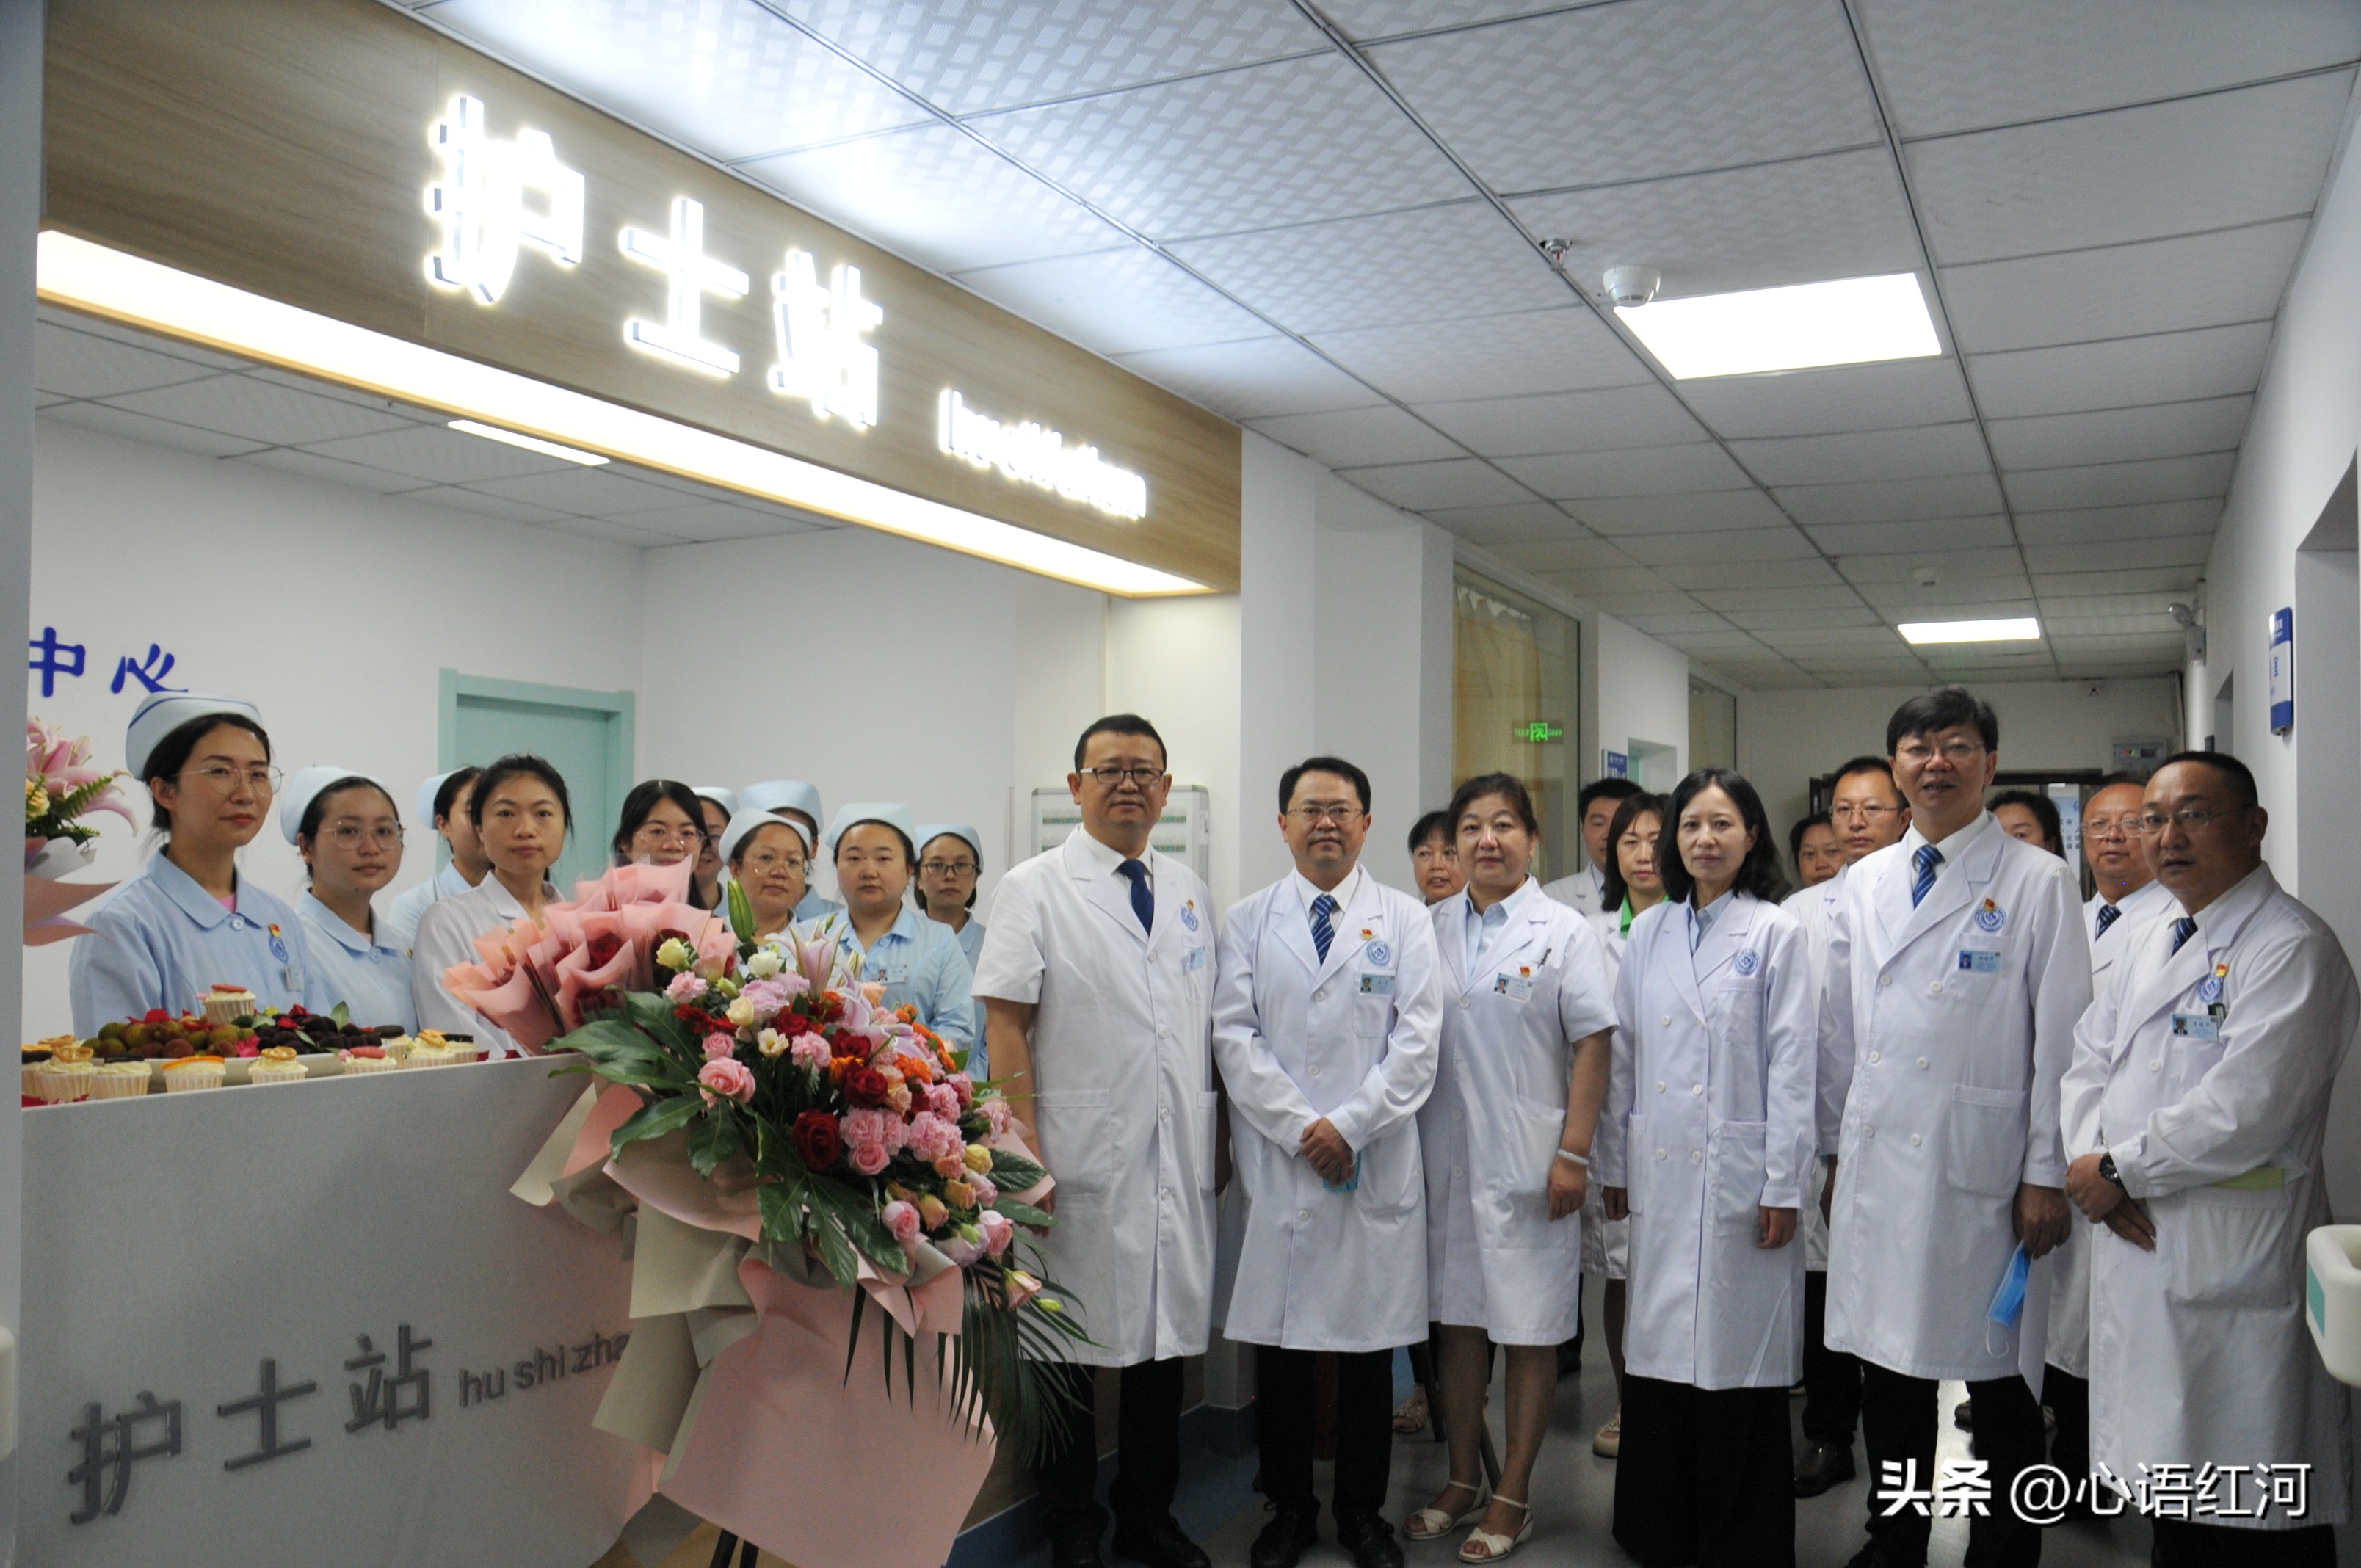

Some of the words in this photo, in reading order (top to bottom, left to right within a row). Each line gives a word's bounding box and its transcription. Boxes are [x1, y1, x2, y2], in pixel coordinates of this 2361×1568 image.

[425, 95, 883, 428] 护士站
[29, 626, 189, 697] 中心
[68, 1324, 432, 1525] 护士站
[458, 1368, 505, 1407] hu
[513, 1343, 565, 1390] shi
